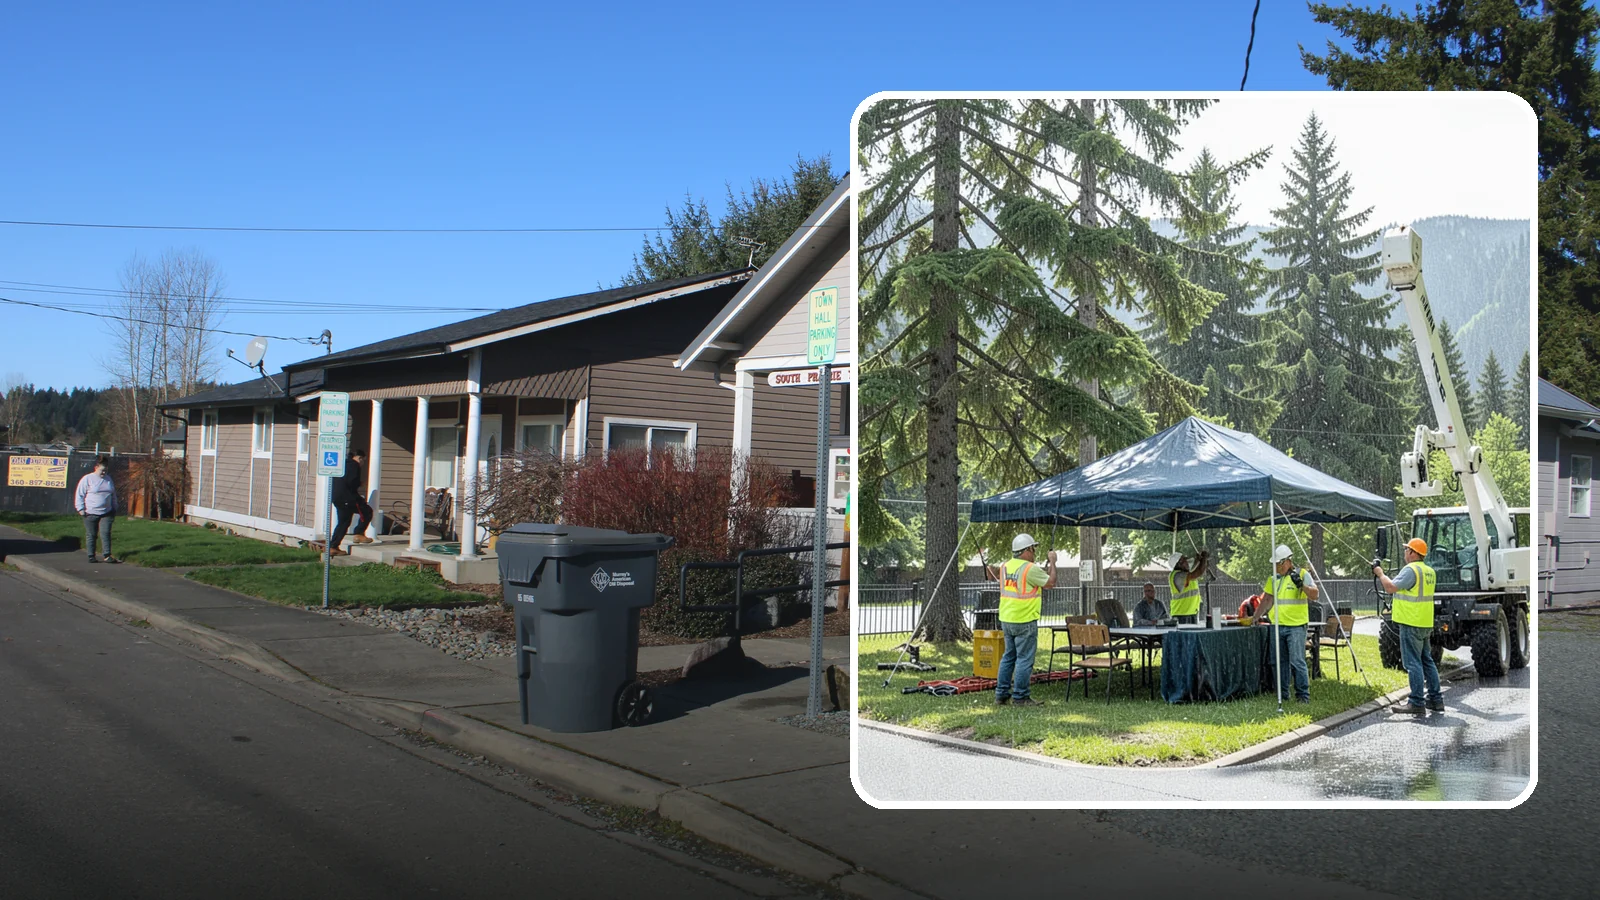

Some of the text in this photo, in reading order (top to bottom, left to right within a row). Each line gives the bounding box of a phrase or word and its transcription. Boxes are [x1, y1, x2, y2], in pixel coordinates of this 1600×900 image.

[815, 294, 833, 308] TOWN
[814, 311, 831, 324] HALL
[810, 326, 836, 340] PARKING
[813, 344, 831, 357] ONLY
[775, 373, 801, 385] SOUTH
[807, 370, 842, 383] PRIE
[325, 420, 340, 428] ONLY
